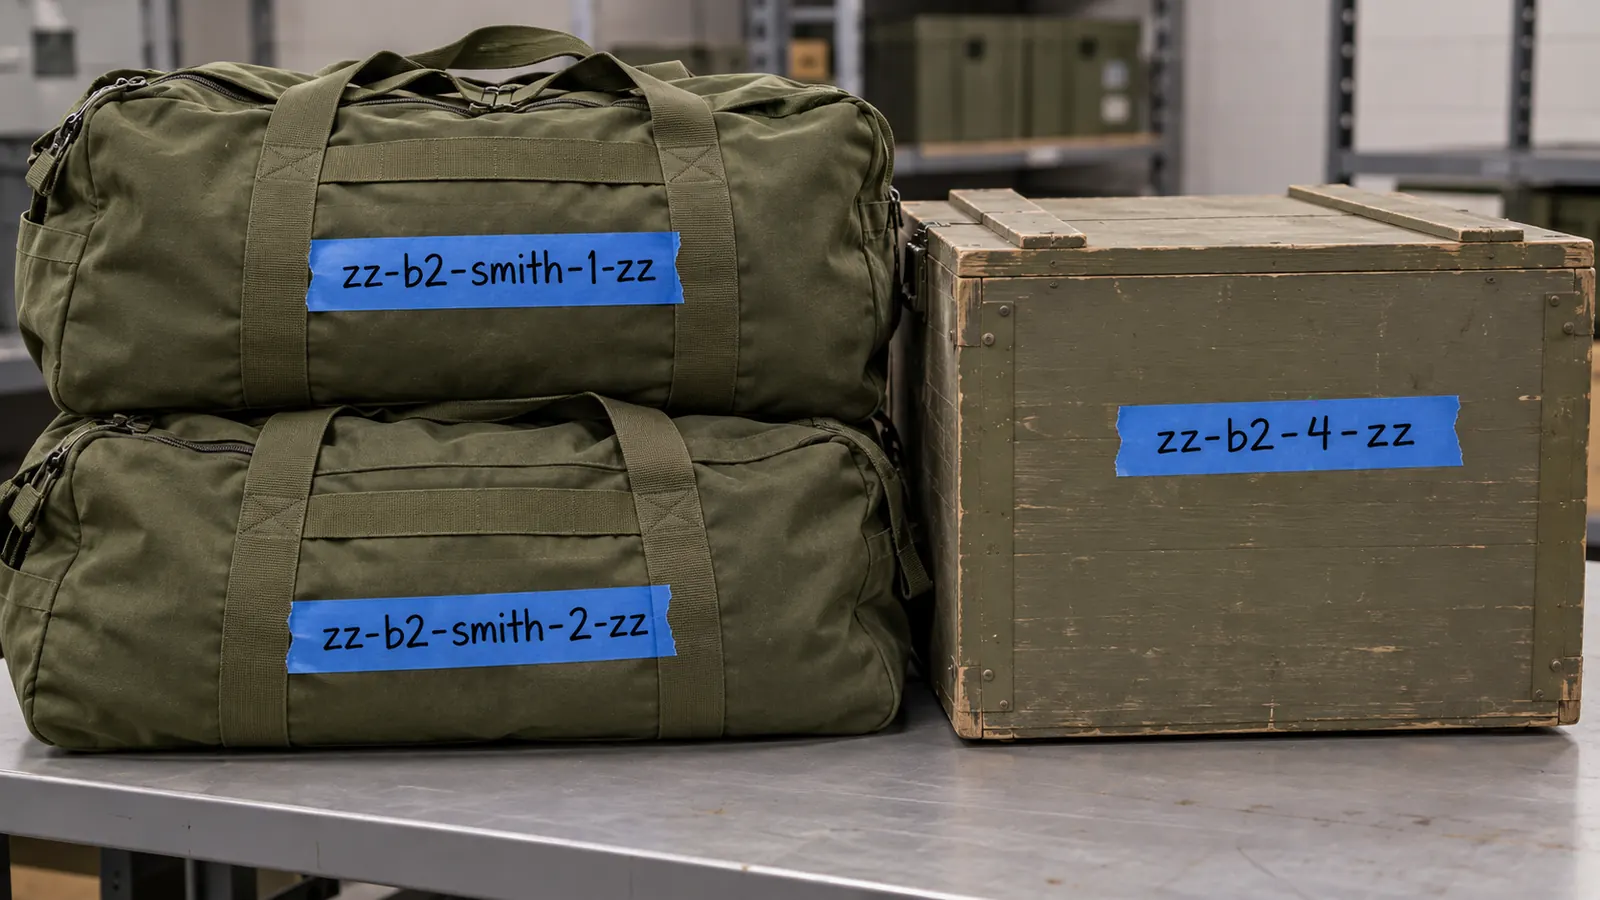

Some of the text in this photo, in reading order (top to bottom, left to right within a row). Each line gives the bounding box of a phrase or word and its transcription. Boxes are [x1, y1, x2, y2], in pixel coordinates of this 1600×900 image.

[342, 249, 657, 289] zz-b2-smith-1-zz
[1157, 415, 1415, 455] zz-b2-4-zz
[322, 606, 649, 652] zz-b2-smith-2-zz
